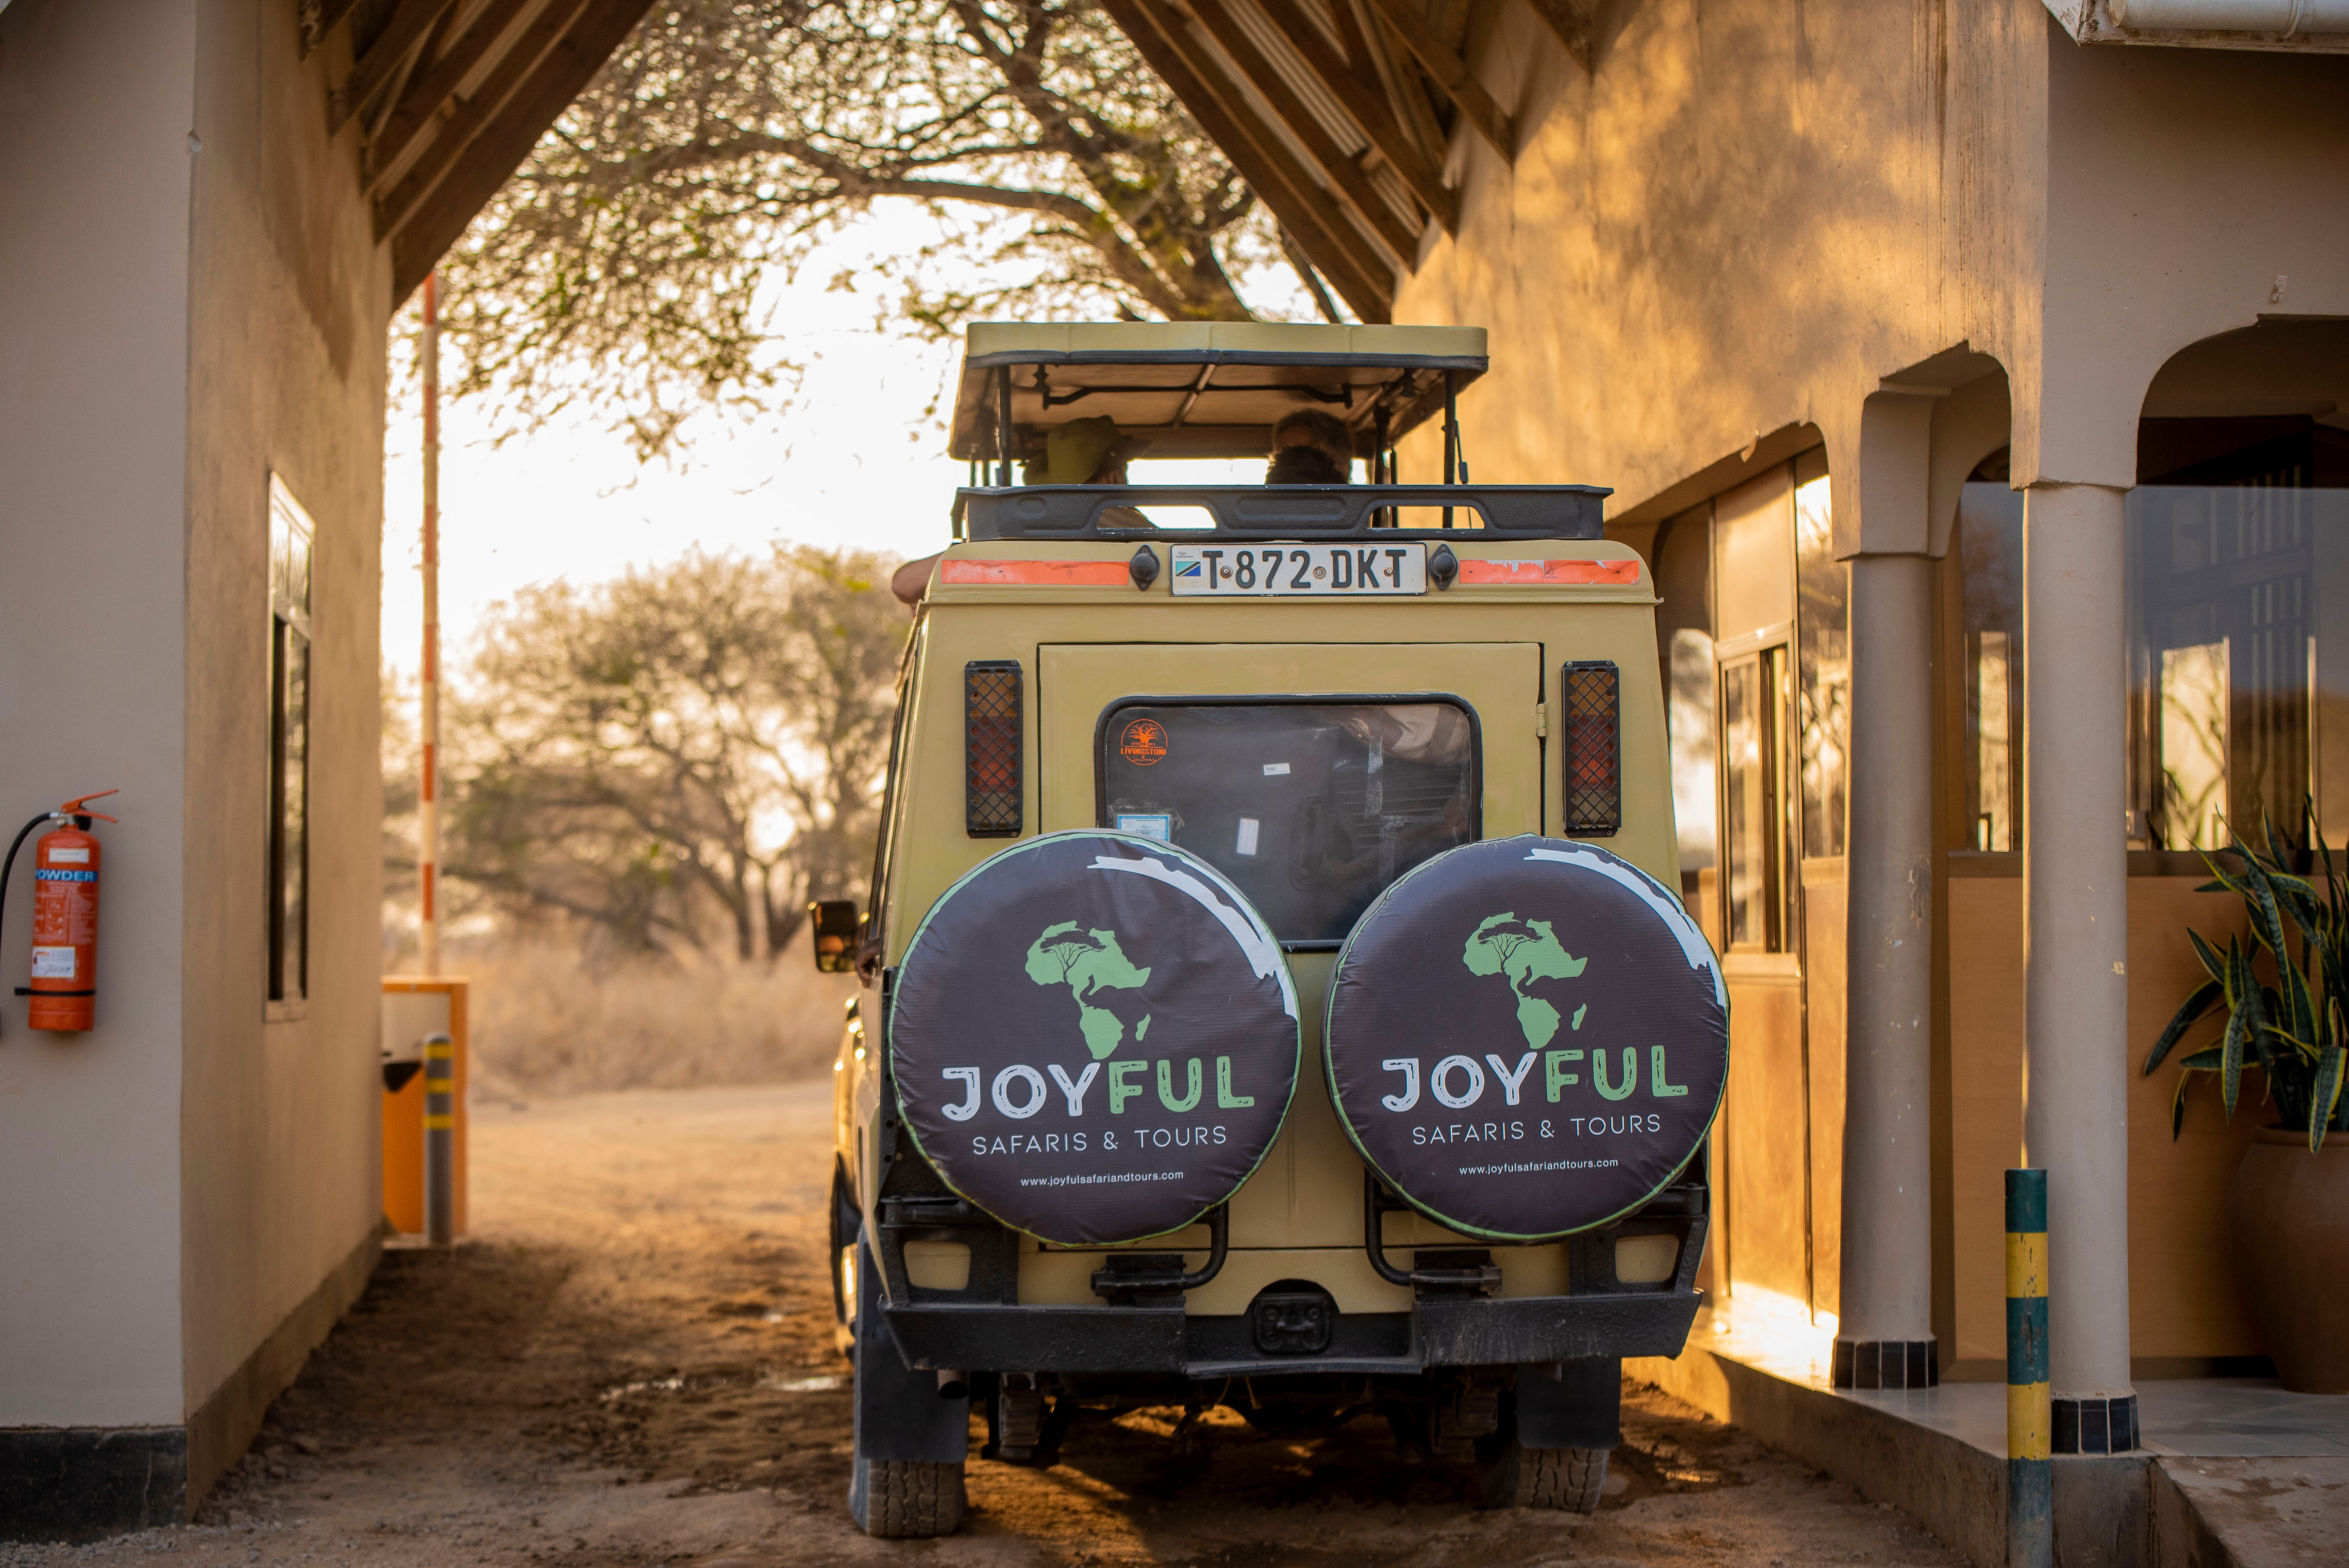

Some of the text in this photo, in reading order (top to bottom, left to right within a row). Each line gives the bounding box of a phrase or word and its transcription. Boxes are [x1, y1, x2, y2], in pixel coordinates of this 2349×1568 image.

[1202, 549, 1407, 589] T 872 DKT
[941, 1056, 1255, 1122] JOYFUL
[1381, 1045, 1689, 1113] JOYFUL
[972, 1126, 1227, 1156] SAFARIS & TOURS
[1412, 1114, 1661, 1145] SAFARIS & TOURS
[1021, 1170, 1184, 1187] www.joyfulsafariandtours.com
[1459, 1158, 1619, 1175] www.joyfulsafariandtours.com
